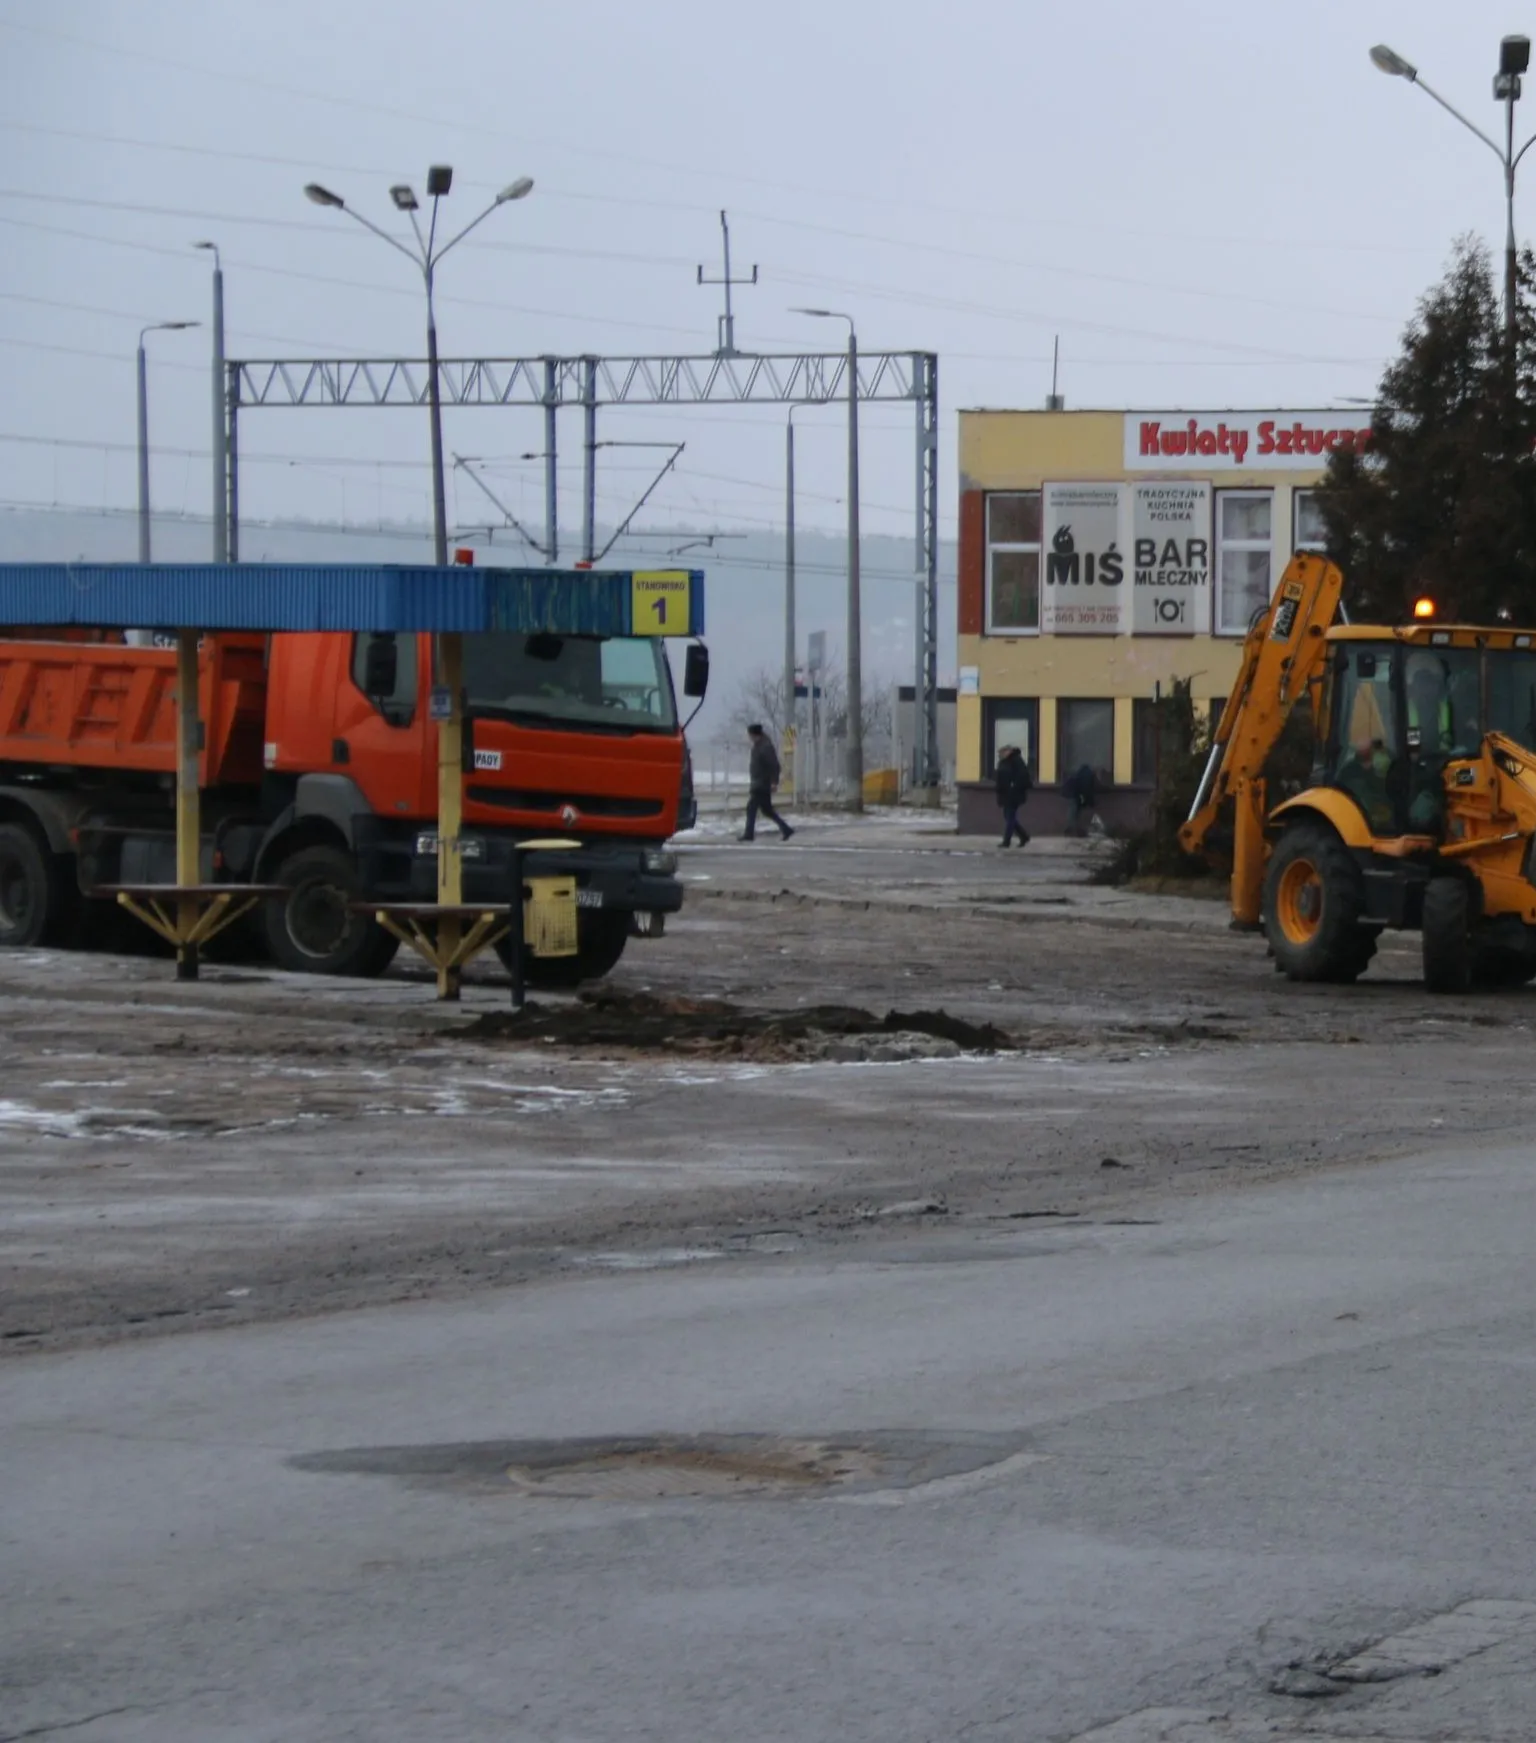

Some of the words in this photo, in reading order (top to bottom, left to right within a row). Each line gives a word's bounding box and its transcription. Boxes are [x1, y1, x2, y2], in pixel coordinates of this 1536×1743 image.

[1139, 418, 1248, 464] Kwiaty
[1137, 489, 1205, 499] TRADYCYJNA
[1146, 501, 1195, 510] KUCHNIA
[1150, 511, 1192, 521] POLSKA
[1046, 541, 1124, 586] MIŚ
[1134, 538, 1208, 568] BAR
[1134, 570, 1208, 586] MLECZNY
[651, 596, 666, 625] 1
